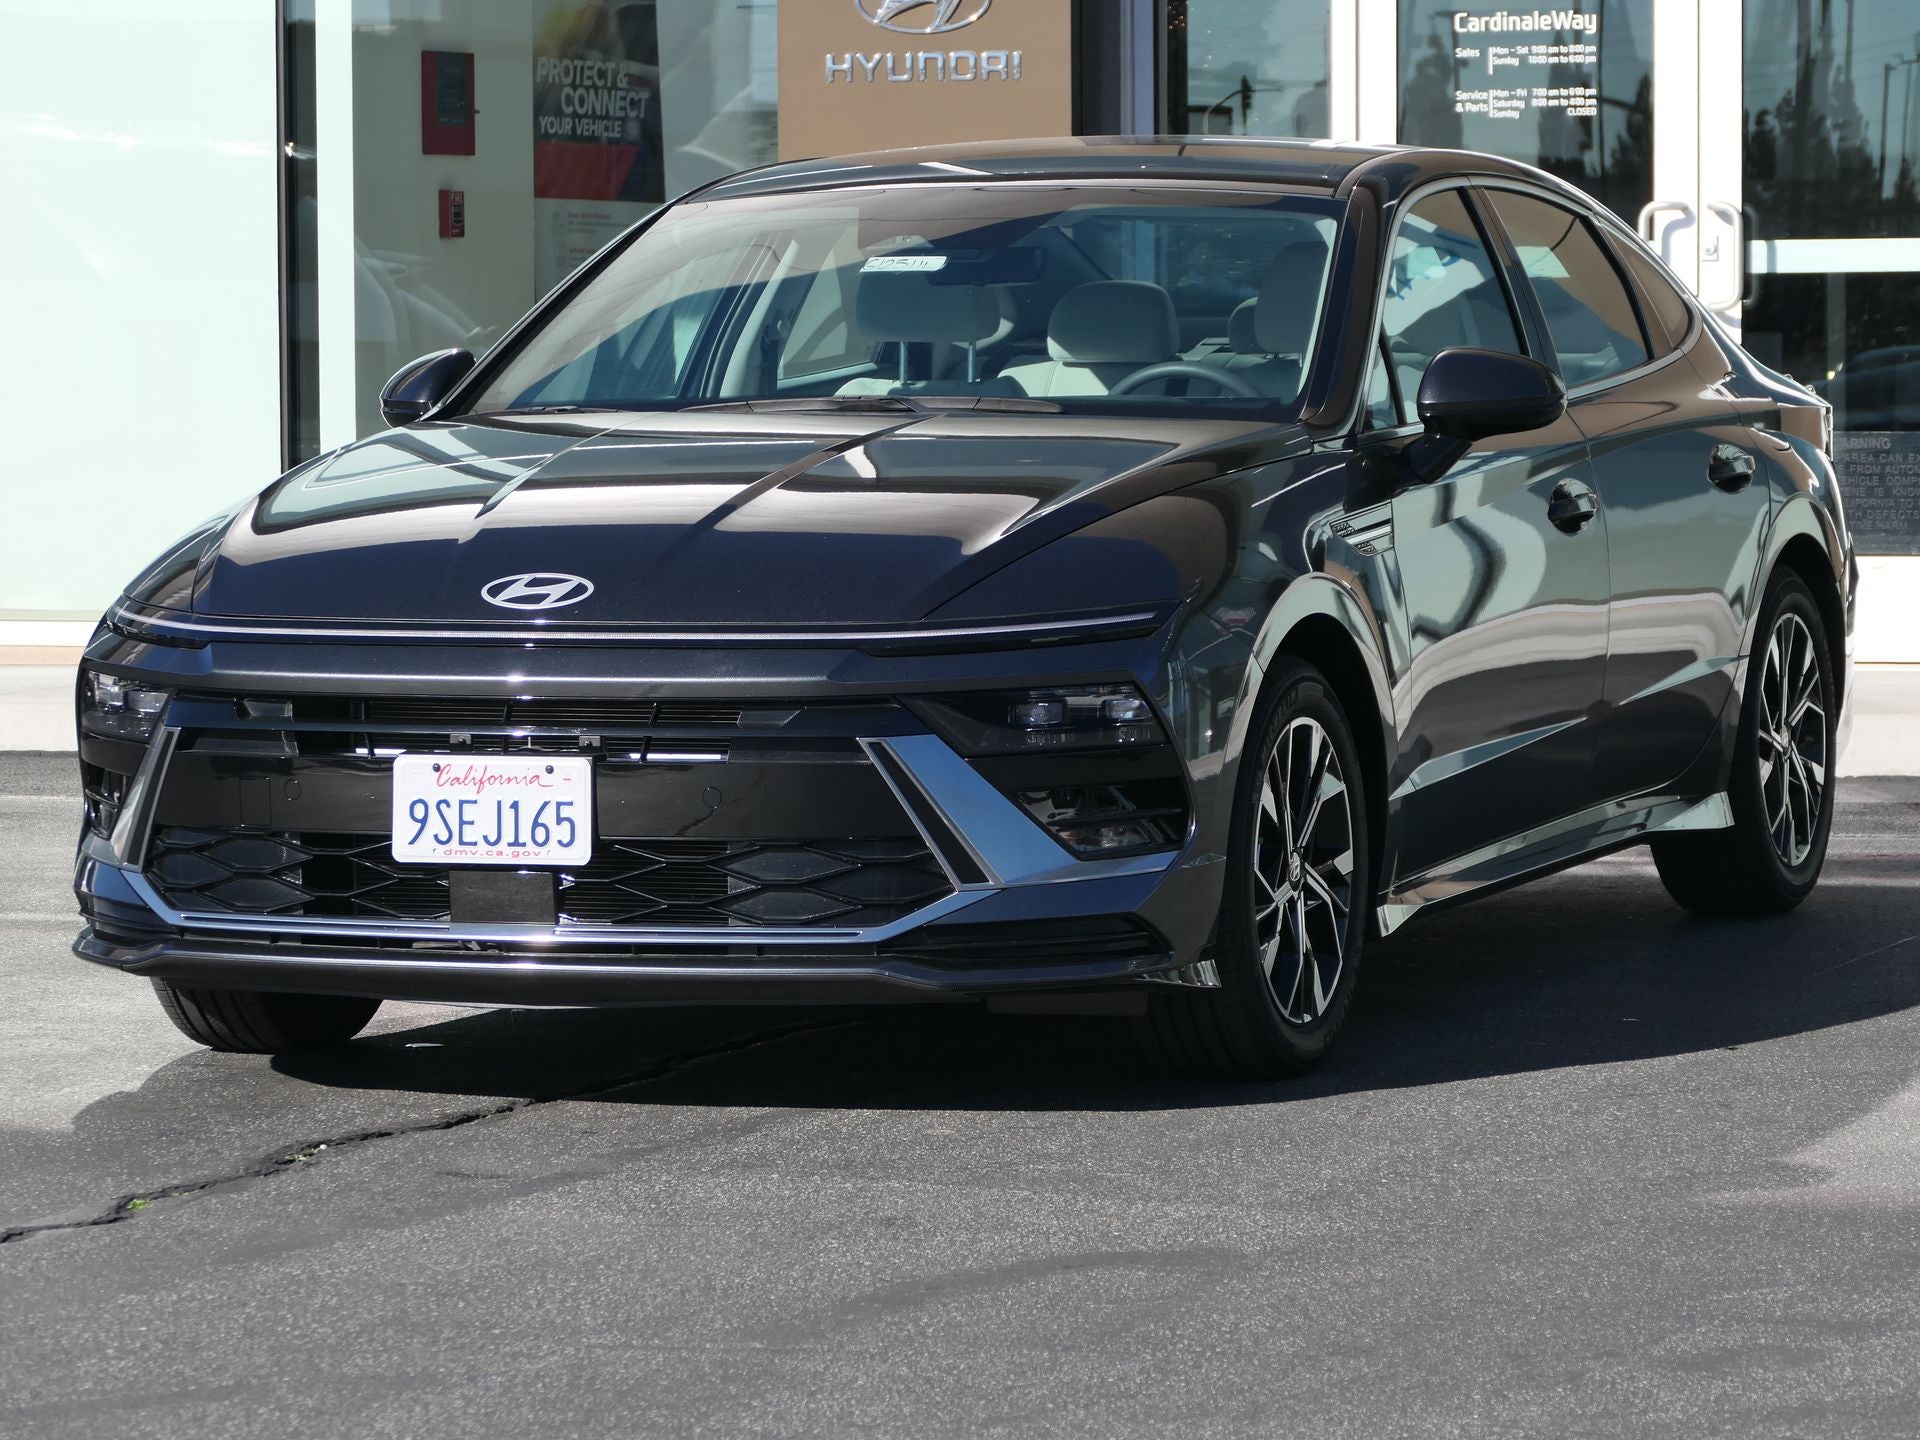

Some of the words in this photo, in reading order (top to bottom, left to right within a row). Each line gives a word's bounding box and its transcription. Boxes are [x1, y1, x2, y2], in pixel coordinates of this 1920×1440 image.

[1453, 10, 1598, 34] CardinaleWay
[1455, 47, 1480, 58] Sales
[1493, 47, 1509, 55] Mon
[1516, 46, 1529, 54] Sat
[1548, 46, 1559, 54] am
[1560, 45, 1568, 54] to
[1585, 45, 1597, 55] pm
[1493, 56, 1519, 66] Sunday
[1528, 55, 1547, 64] 10:00
[1548, 56, 1559, 64] am
[1560, 55, 1568, 63] to
[1585, 55, 1597, 65] pm
[825, 50, 1023, 84] HYUNDAI
[536, 57, 616, 88] PROTECT
[616, 62, 629, 89] &
[1455, 90, 1488, 101] Service
[1493, 89, 1509, 97] Mon
[1516, 88, 1527, 97] Fri
[1532, 88, 1547, 97] 7:00
[1548, 89, 1559, 97] am
[1560, 88, 1568, 97] to
[1569, 87, 1584, 96] 6:00
[1585, 88, 1597, 98] pm
[561, 86, 650, 119] CONNECT
[1455, 102, 1463, 113] &
[1465, 102, 1488, 113] Parts
[1493, 99, 1525, 109] Saturday
[1548, 98, 1559, 107] am
[1560, 97, 1568, 106] to
[1585, 98, 1597, 108] pm
[1493, 109, 1520, 120] Sunday
[1566, 107, 1597, 117] CLOSED
[539, 115, 573, 135] YOUR
[575, 117, 623, 138] VEHICLE
[1839, 436, 1891, 450] ARNING
[1879, 453, 1904, 464] CAN
[1850, 464, 1882, 475] FROM
[1839, 475, 1880, 486] EHICLE
[436, 763, 554, 794] California
[407, 798, 576, 848] 9SEJ165
[443, 848, 541, 859] dmv.ca.gov
